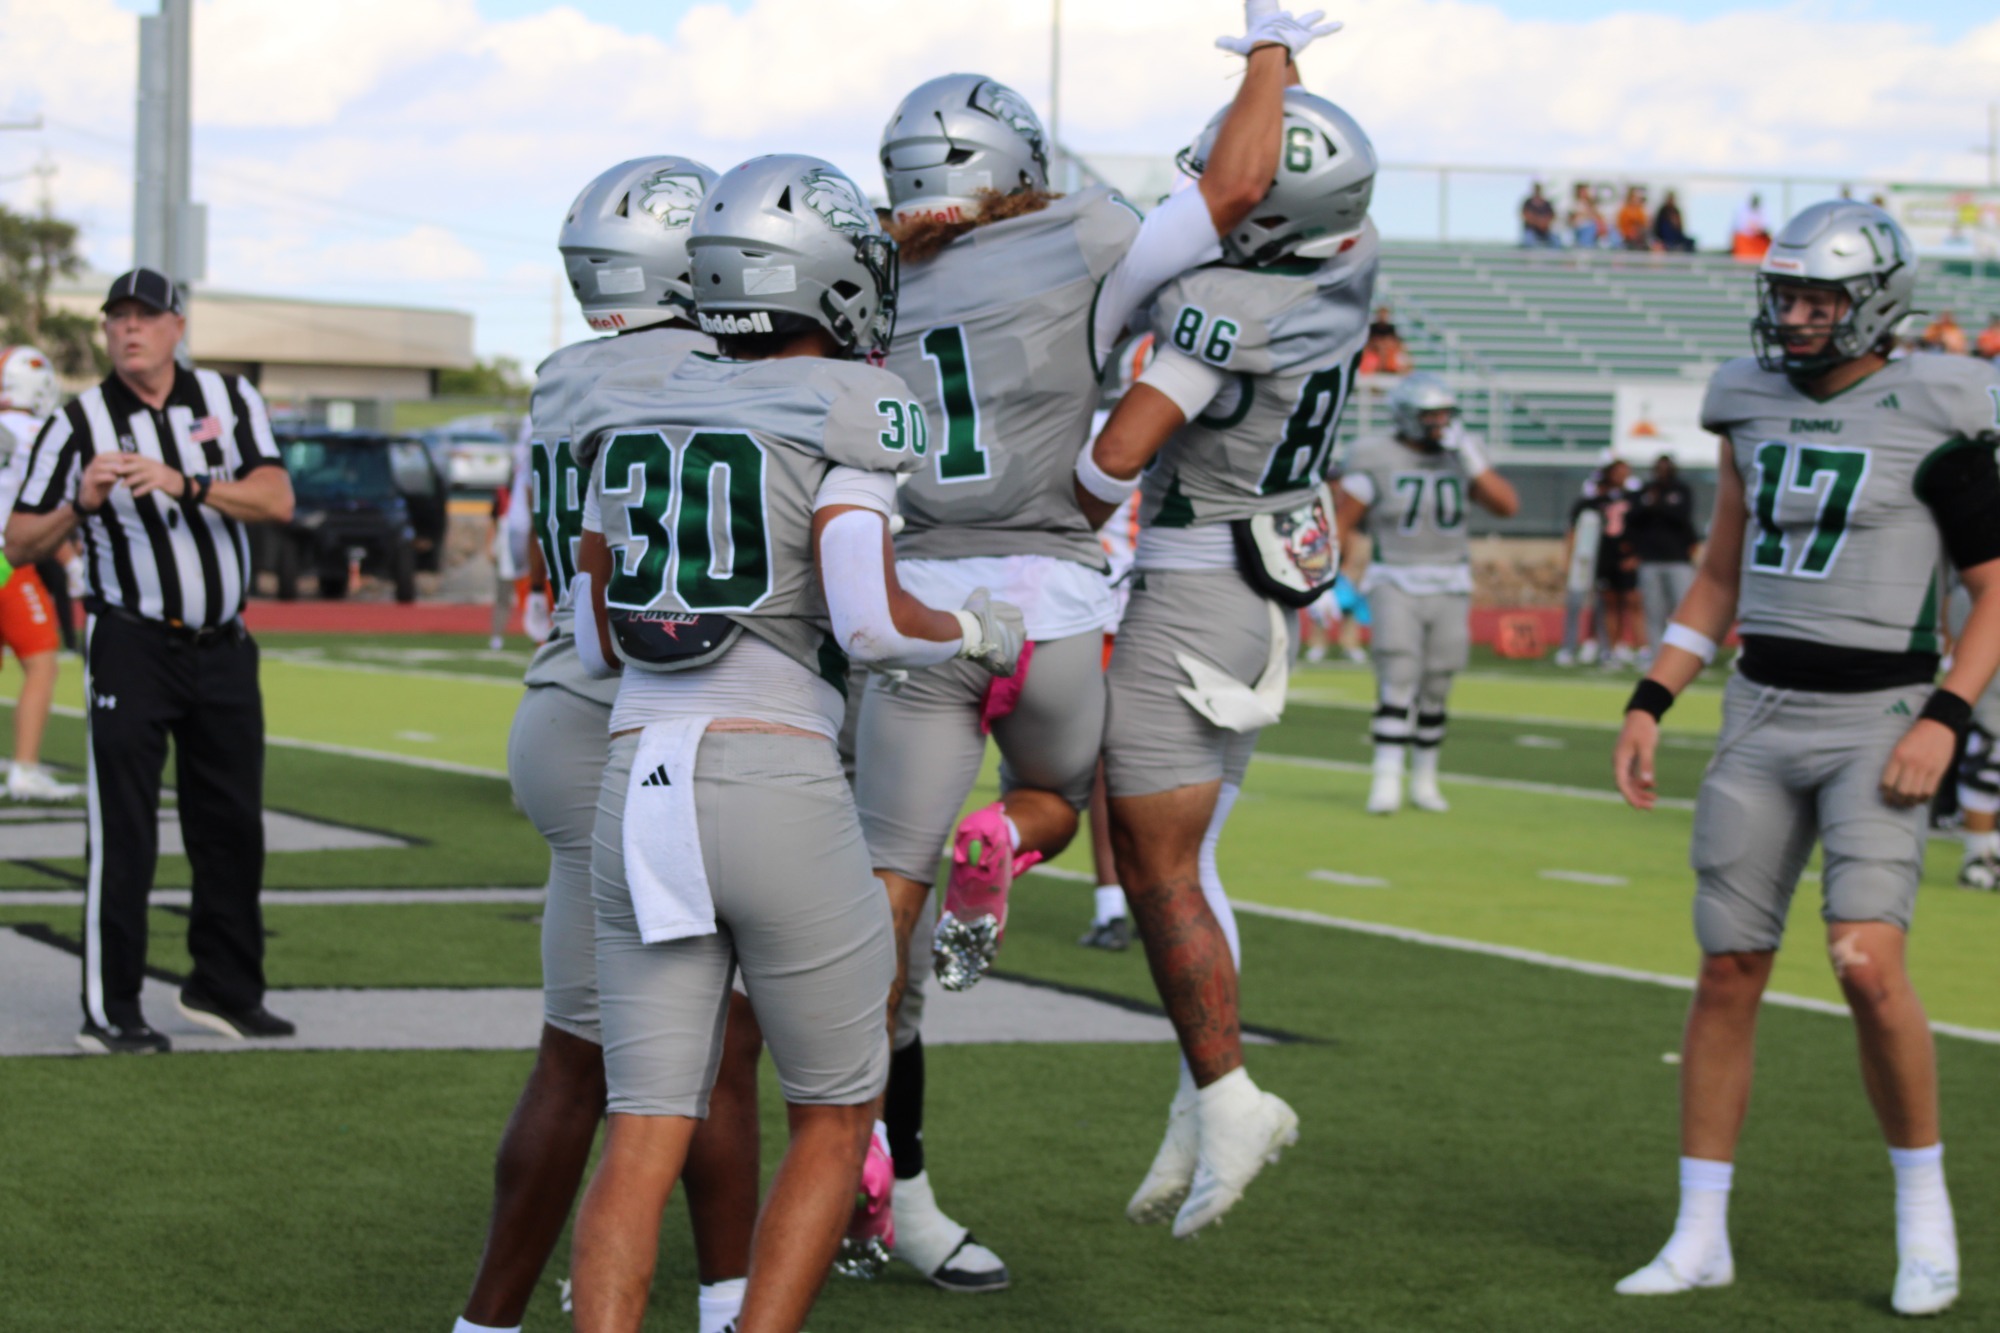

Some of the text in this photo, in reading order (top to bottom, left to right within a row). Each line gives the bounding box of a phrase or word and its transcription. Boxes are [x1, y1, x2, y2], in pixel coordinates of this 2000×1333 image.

[1859, 222, 1903, 266] 17
[1172, 305, 1242, 366] 86
[877, 399, 929, 456] 30
[920, 324, 992, 484] 1
[601, 429, 772, 613] 30
[1393, 472, 1465, 536] 70
[1751, 441, 1872, 580] 17
